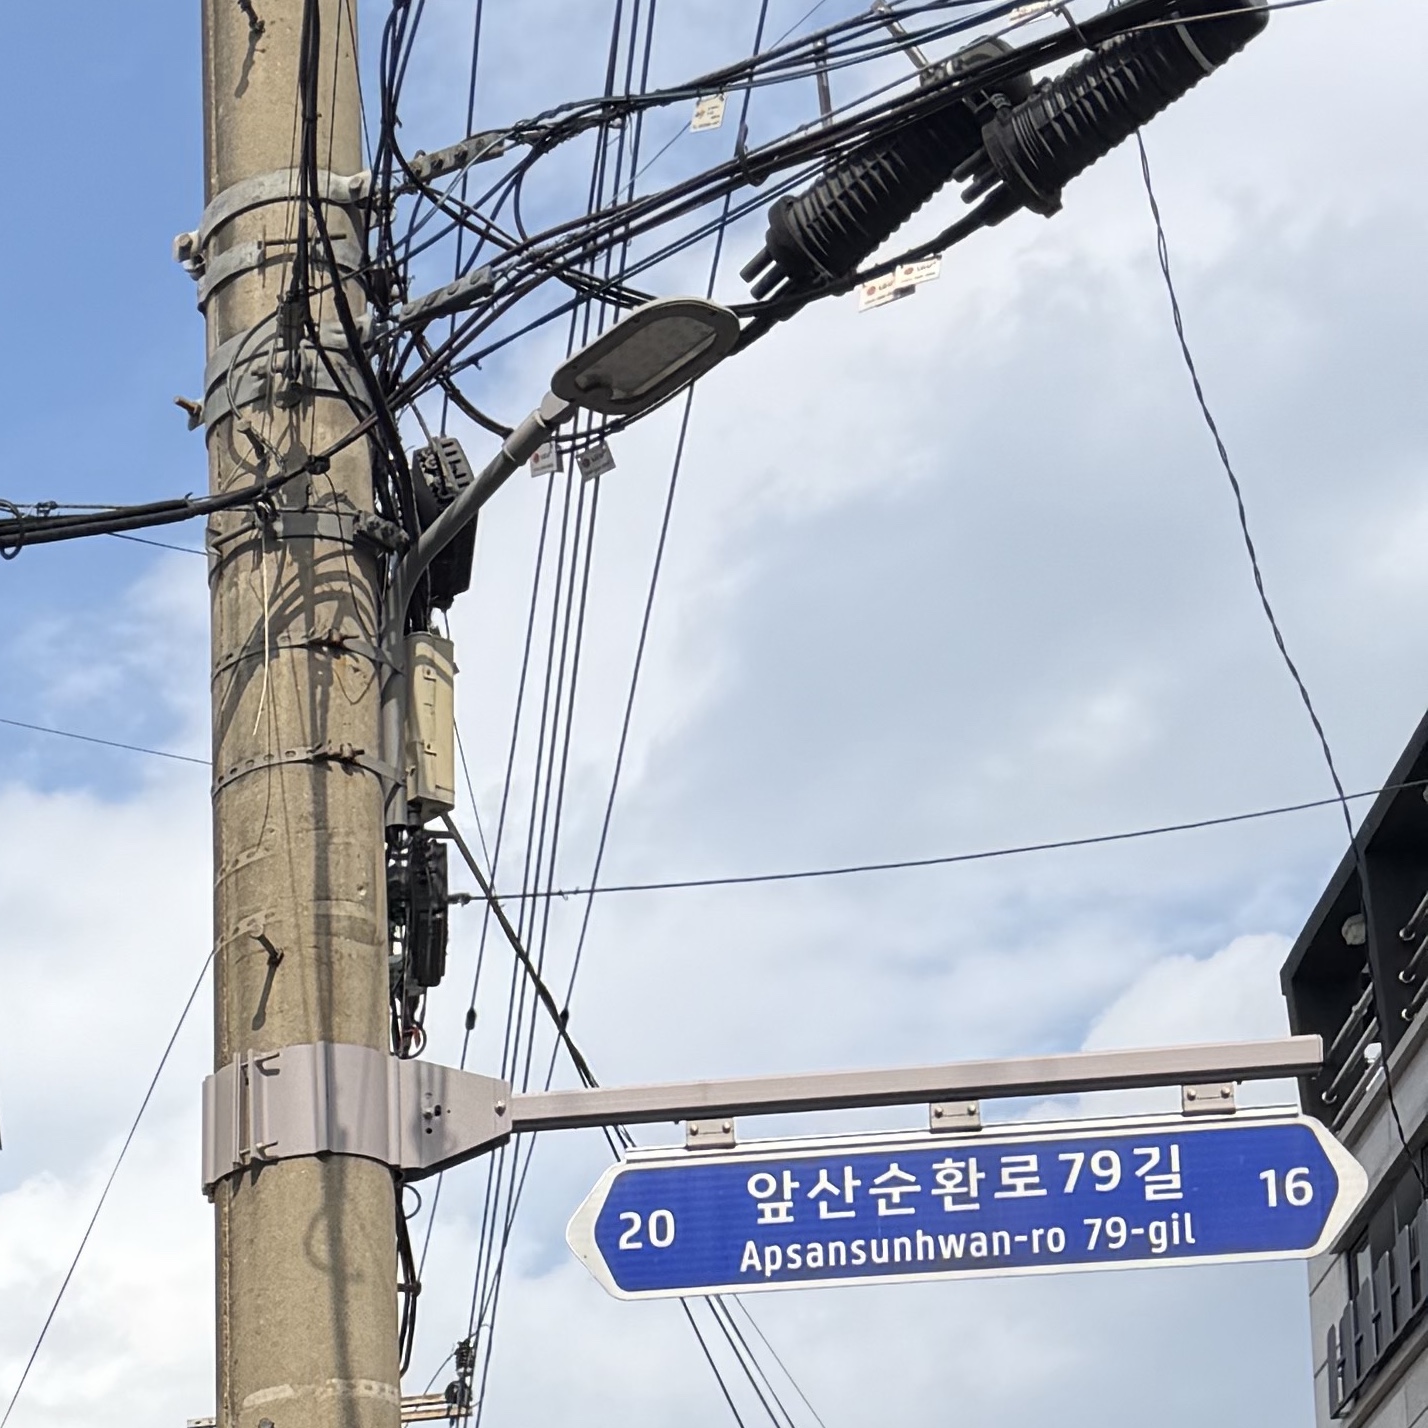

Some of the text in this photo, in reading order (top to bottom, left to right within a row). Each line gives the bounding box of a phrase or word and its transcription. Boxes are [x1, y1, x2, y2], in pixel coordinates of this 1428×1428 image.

[746, 1143, 1184, 1225] 앞산순환로79길
[1259, 1166, 1313, 1208] 16
[619, 1209, 675, 1250] 20
[740, 1211, 1196, 1277] Apsansunhwan-ro 79-gil
